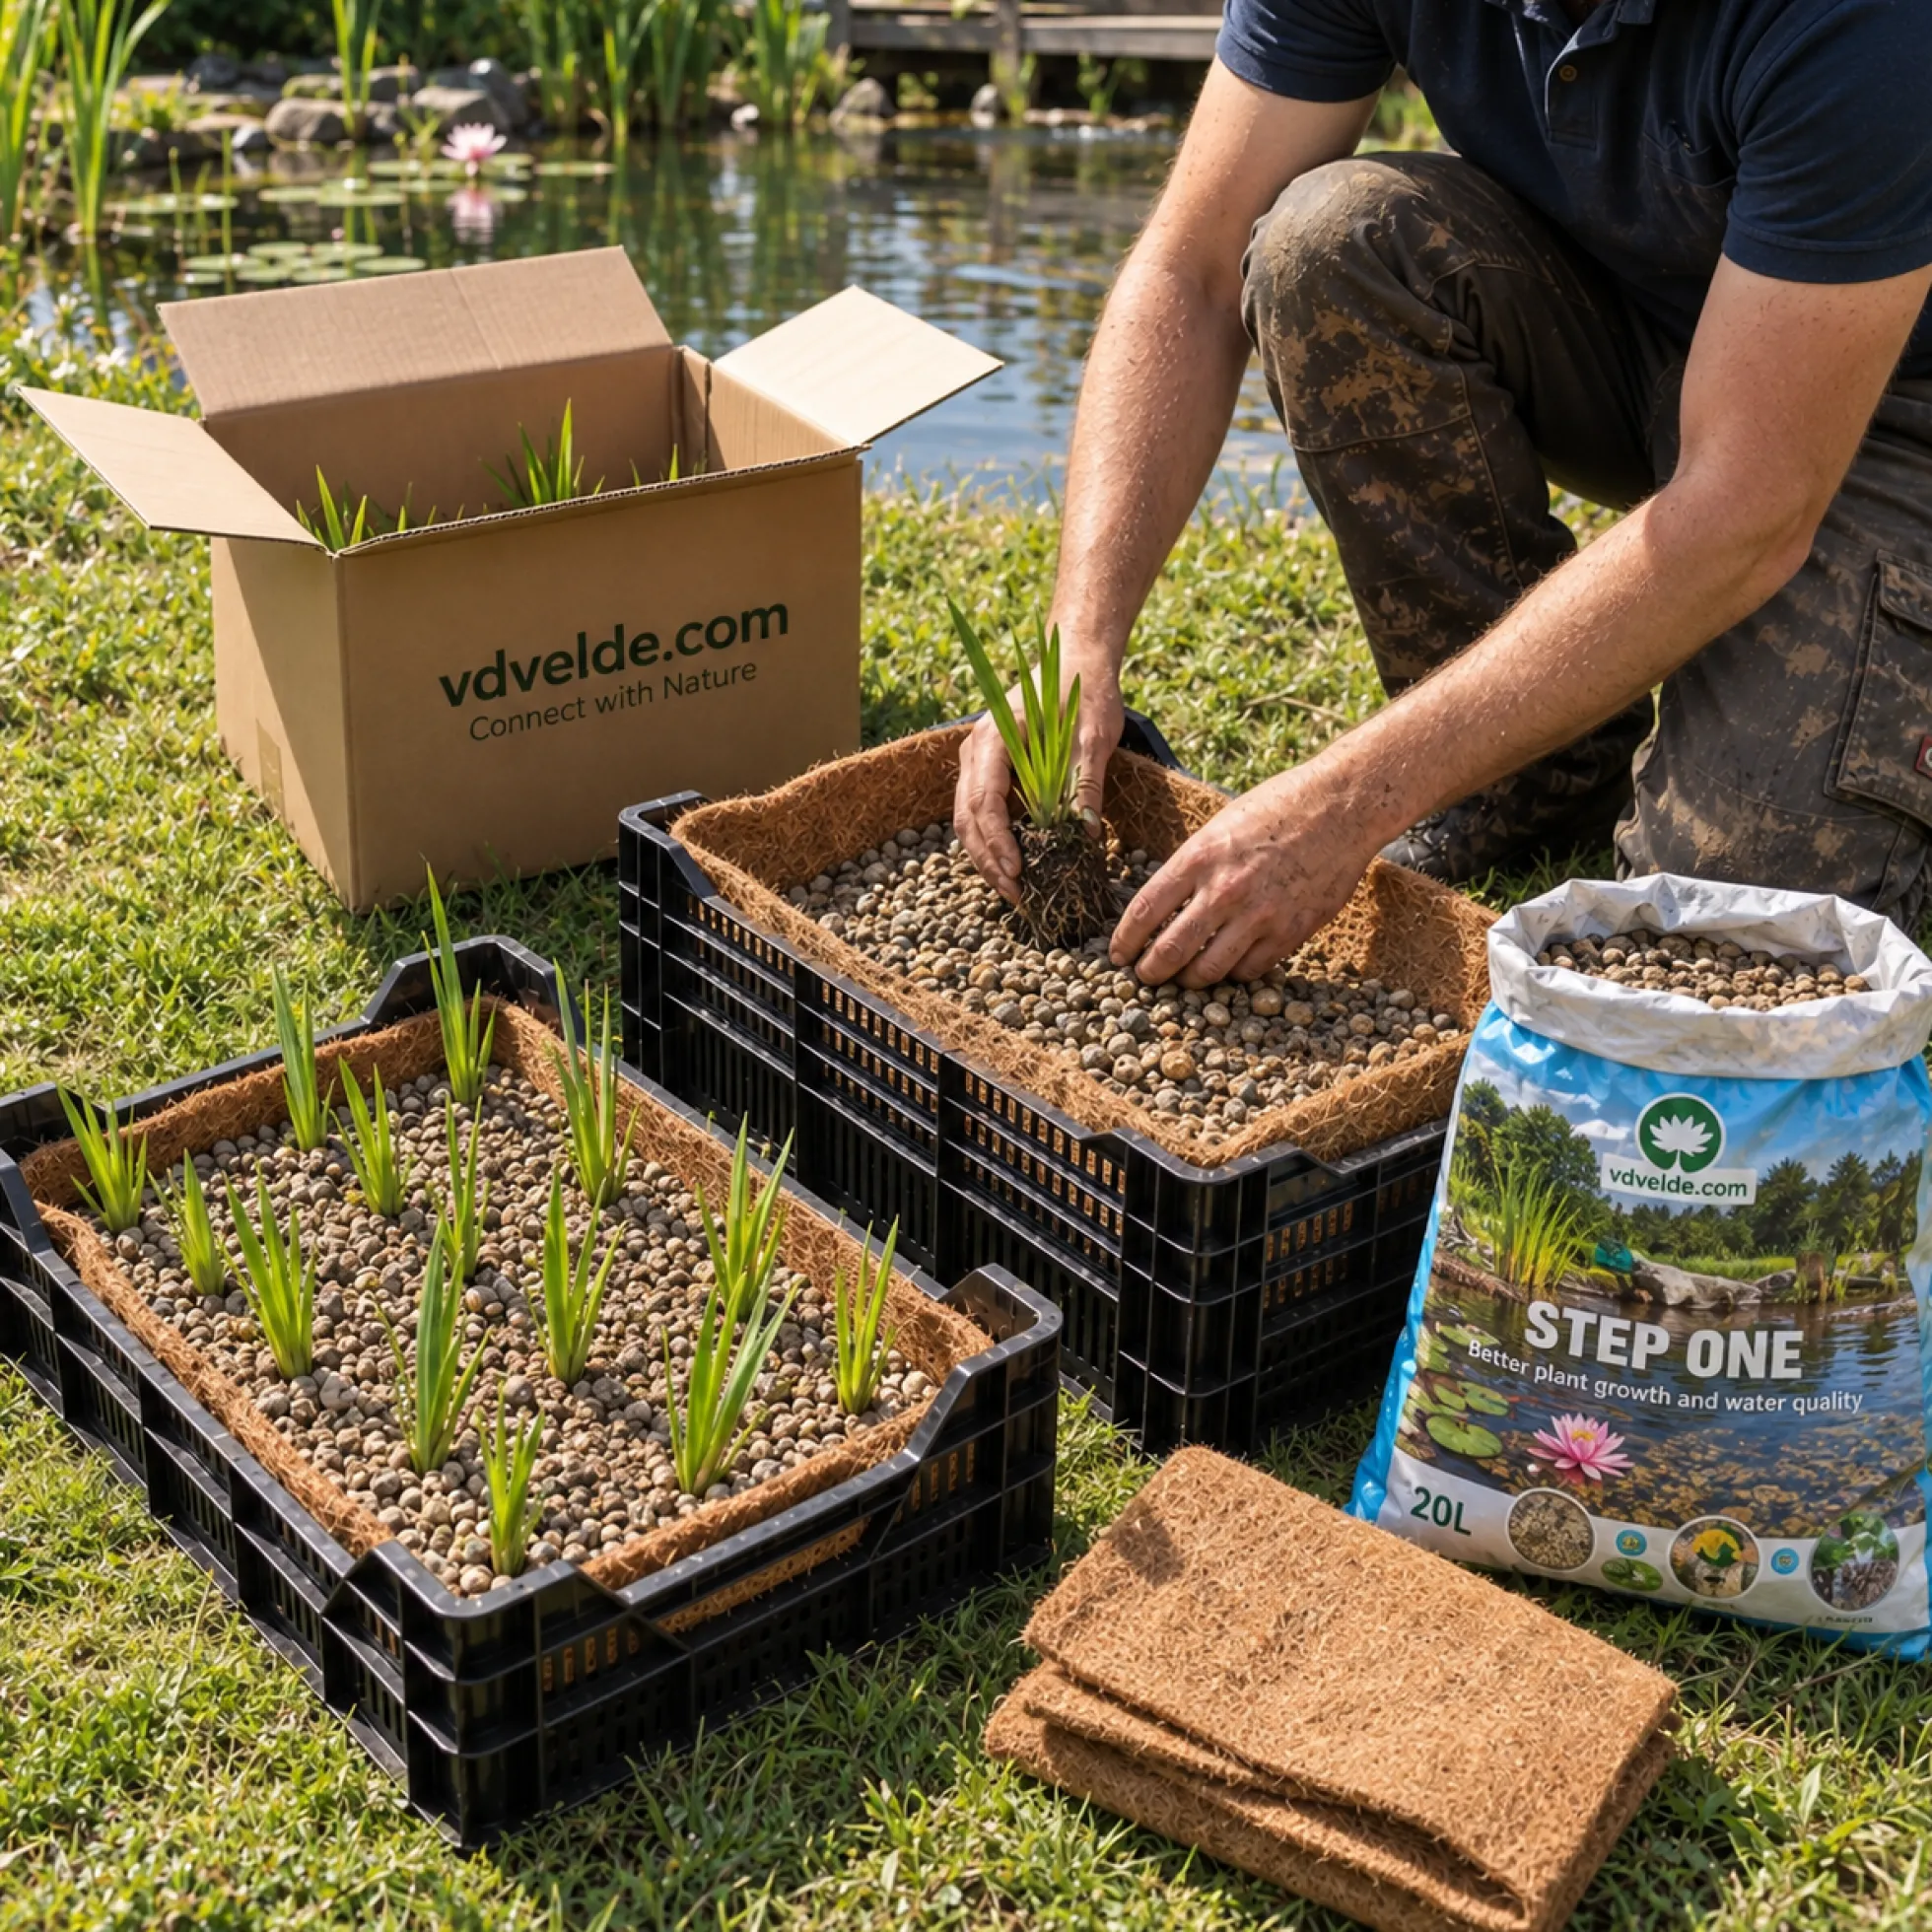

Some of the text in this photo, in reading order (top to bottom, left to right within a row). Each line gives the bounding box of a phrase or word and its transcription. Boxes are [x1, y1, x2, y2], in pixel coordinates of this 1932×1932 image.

[439, 602, 789, 708] vdvelde.com
[469, 661, 758, 741] Connect with Nature
[1609, 1166, 1748, 1198] vdvelde.com
[1468, 1339, 1863, 1416] Better plant growth and water quality
[1524, 1300, 1804, 1379] STEP ONE
[1410, 1485, 1472, 1536] 20L
